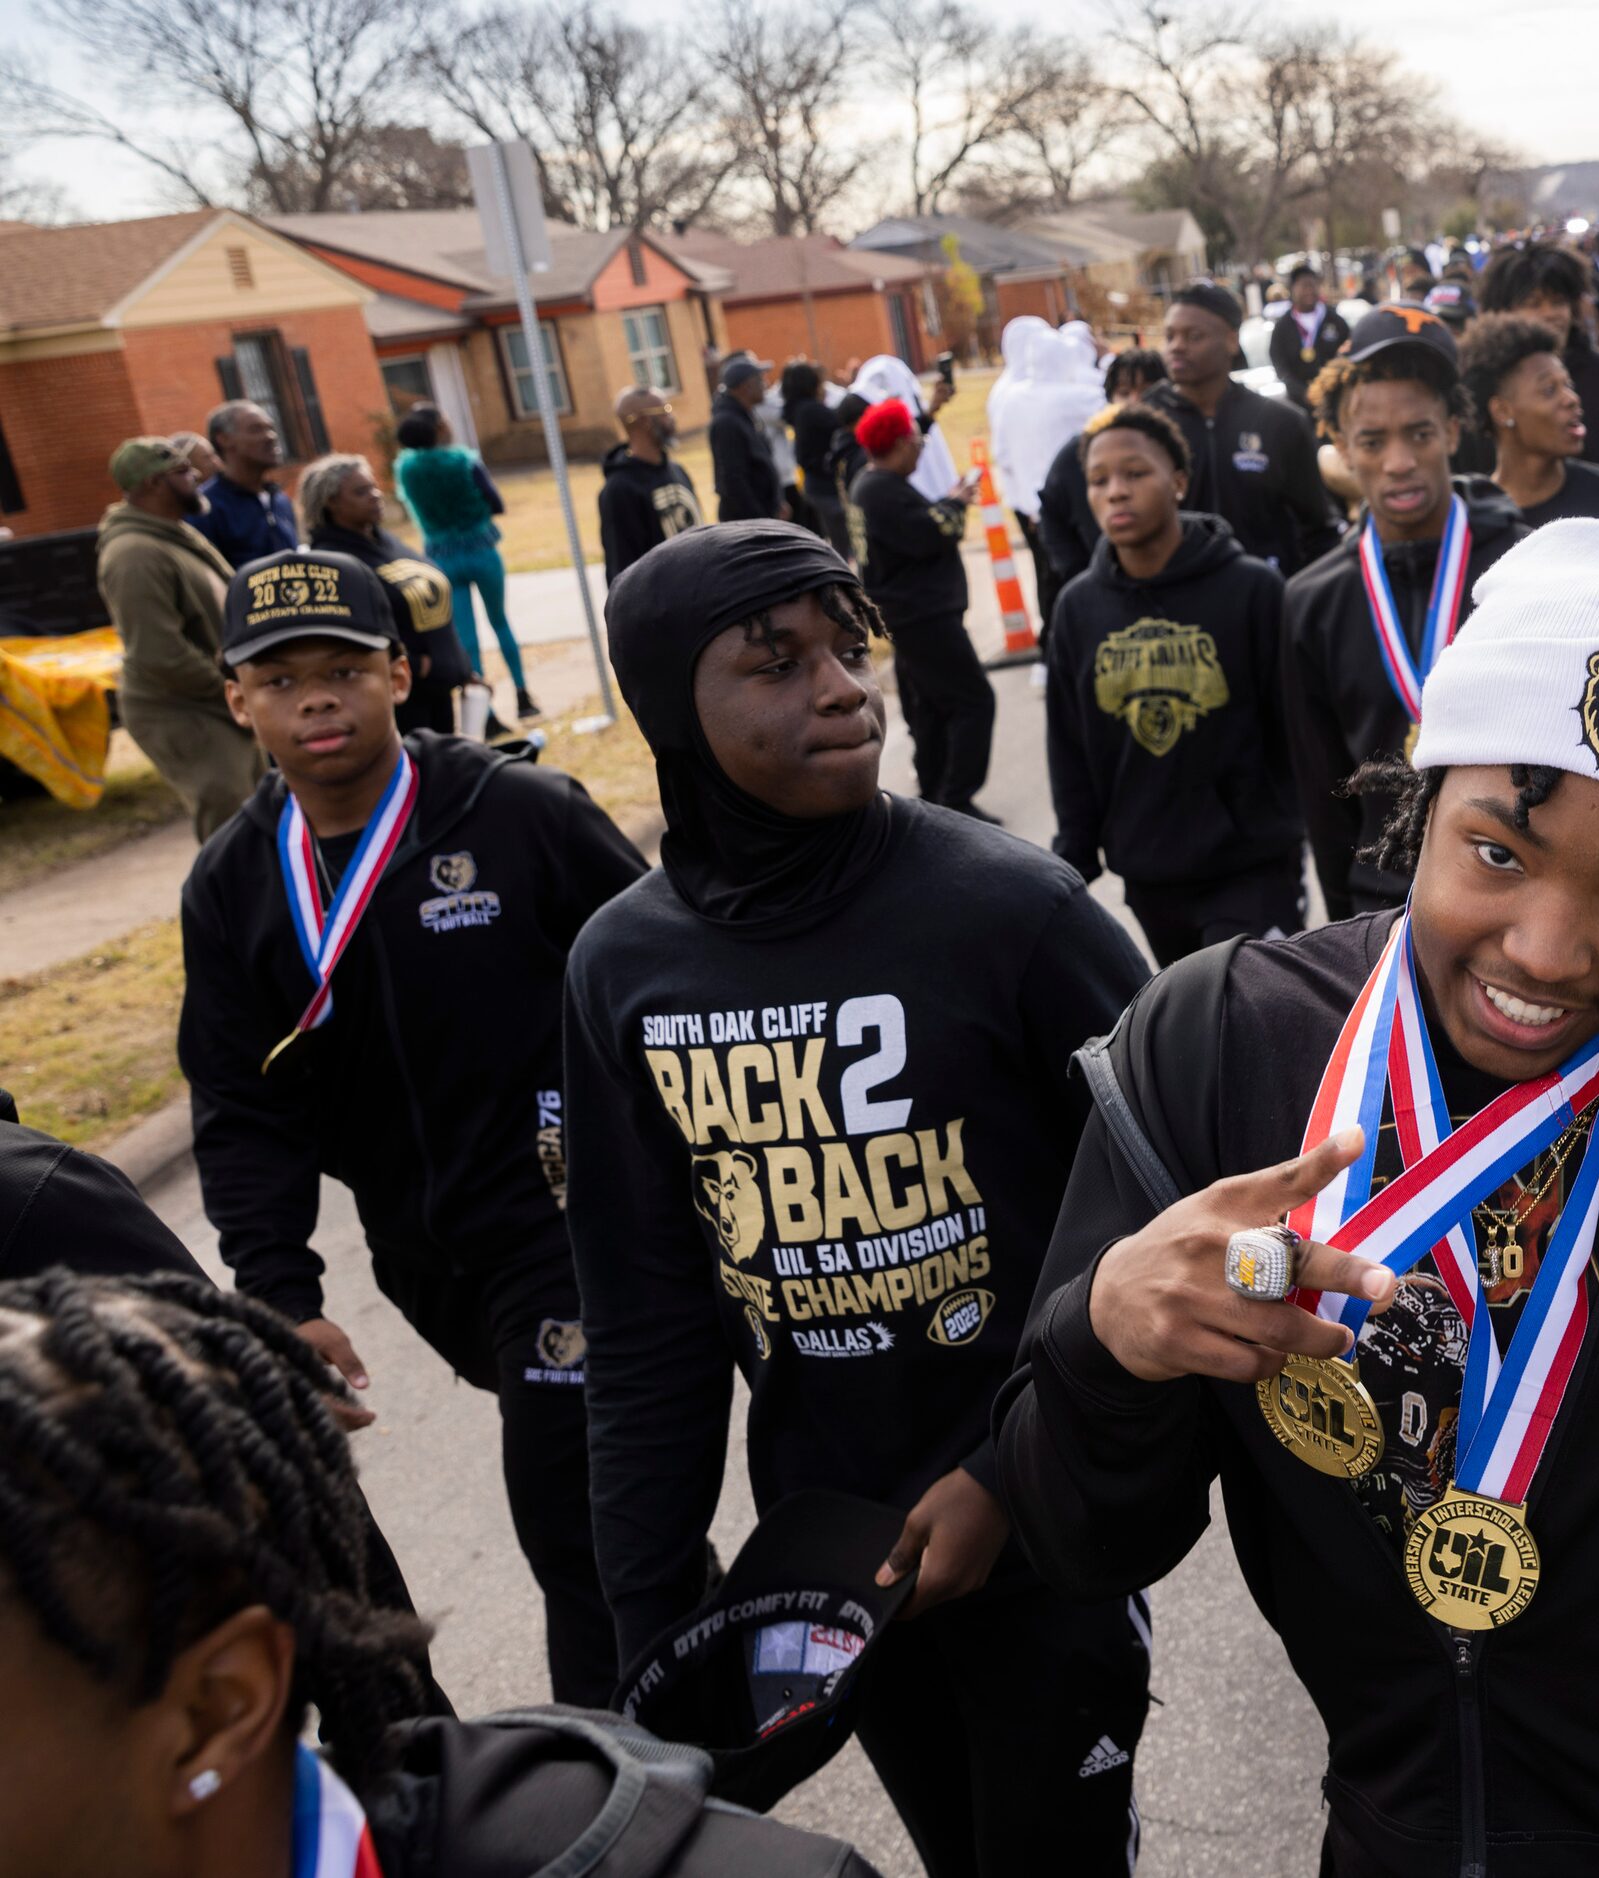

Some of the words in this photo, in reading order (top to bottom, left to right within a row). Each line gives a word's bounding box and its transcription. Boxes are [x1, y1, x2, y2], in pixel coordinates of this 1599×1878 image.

[281, 563, 306, 579] OAK
[252, 583, 275, 609] 20
[314, 580, 340, 602] 22
[643, 1013, 704, 1046] SOUTH
[709, 1009, 758, 1044] OAK
[761, 1001, 828, 1038] CLIFF
[644, 1037, 838, 1146] BACK
[836, 993, 914, 1136] 2
[536, 1090, 562, 1128] 76
[763, 1117, 984, 1244] BACK
[771, 1245, 812, 1277] UIL
[819, 1243, 853, 1273] 5A
[856, 1217, 965, 1269] DIVISION
[969, 1207, 987, 1232] II
[718, 1258, 781, 1323] STATE
[780, 1236, 992, 1322] CHAMPIONS
[792, 1327, 872, 1351] DALLAS
[945, 1302, 981, 1341] 2022
[1279, 1373, 1355, 1449] UIL
[1293, 1422, 1342, 1457] STATE
[1346, 1437, 1378, 1477] LEAGUE
[1432, 1502, 1538, 1569] INTERSCHOLASTIC
[1405, 1524, 1430, 1606] UNIVERSITY
[1429, 1526, 1510, 1596] UIL
[1438, 1580, 1491, 1607] STATE
[1492, 1578, 1537, 1625] LEAGUE
[639, 1659, 665, 1693] FIT
[673, 1610, 726, 1660] OTTO
[728, 1591, 798, 1622] COMFY
[797, 1591, 829, 1610] FIT
[1079, 1750, 1130, 1778] adidas
